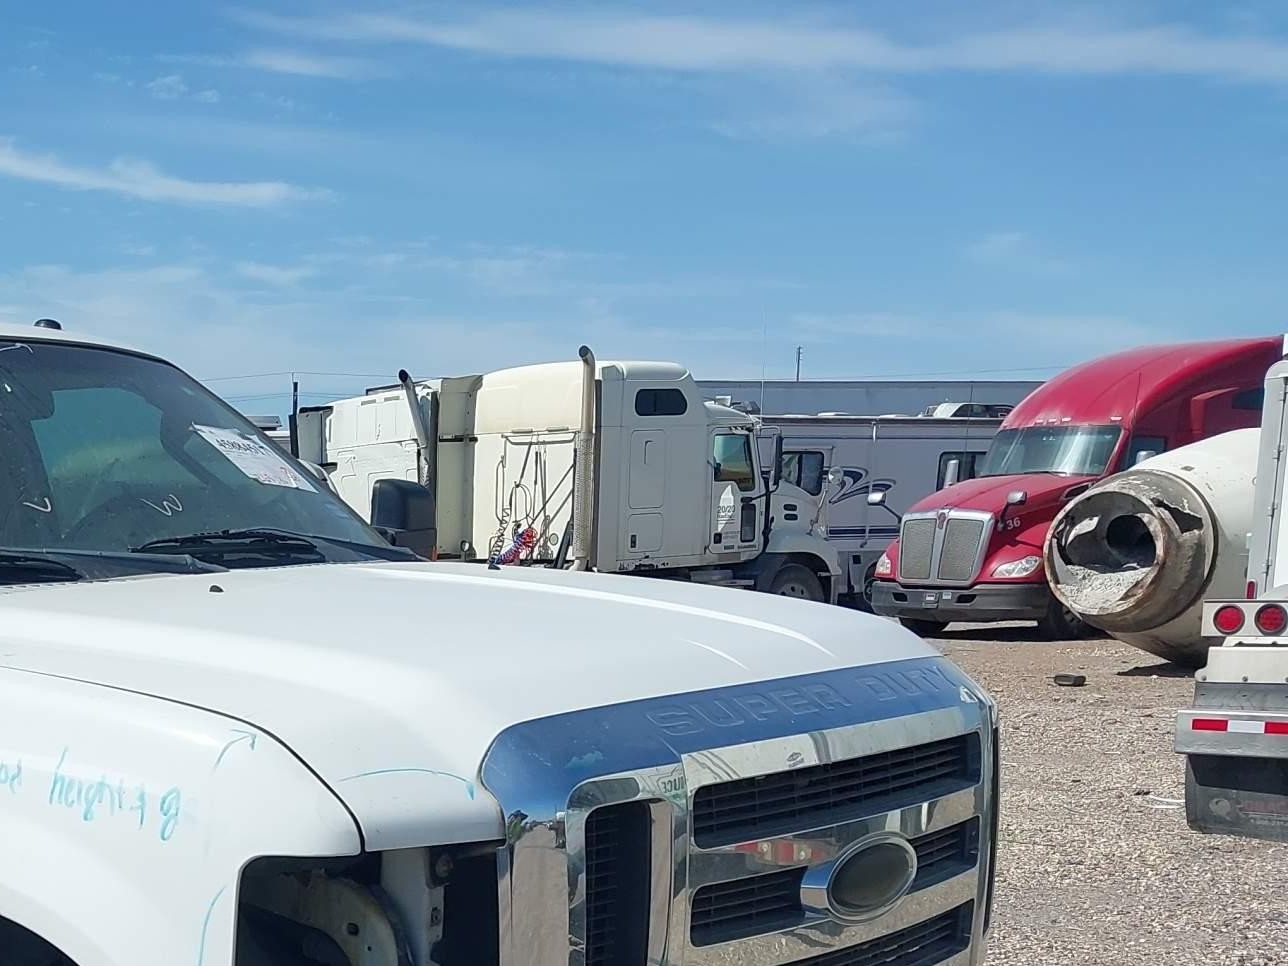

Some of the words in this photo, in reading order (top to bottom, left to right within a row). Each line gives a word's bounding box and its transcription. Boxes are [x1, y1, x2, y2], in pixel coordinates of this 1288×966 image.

[1006, 516, 1021, 530] 36
[645, 683, 854, 736] SUPER
[857, 664, 958, 702] DUTY
